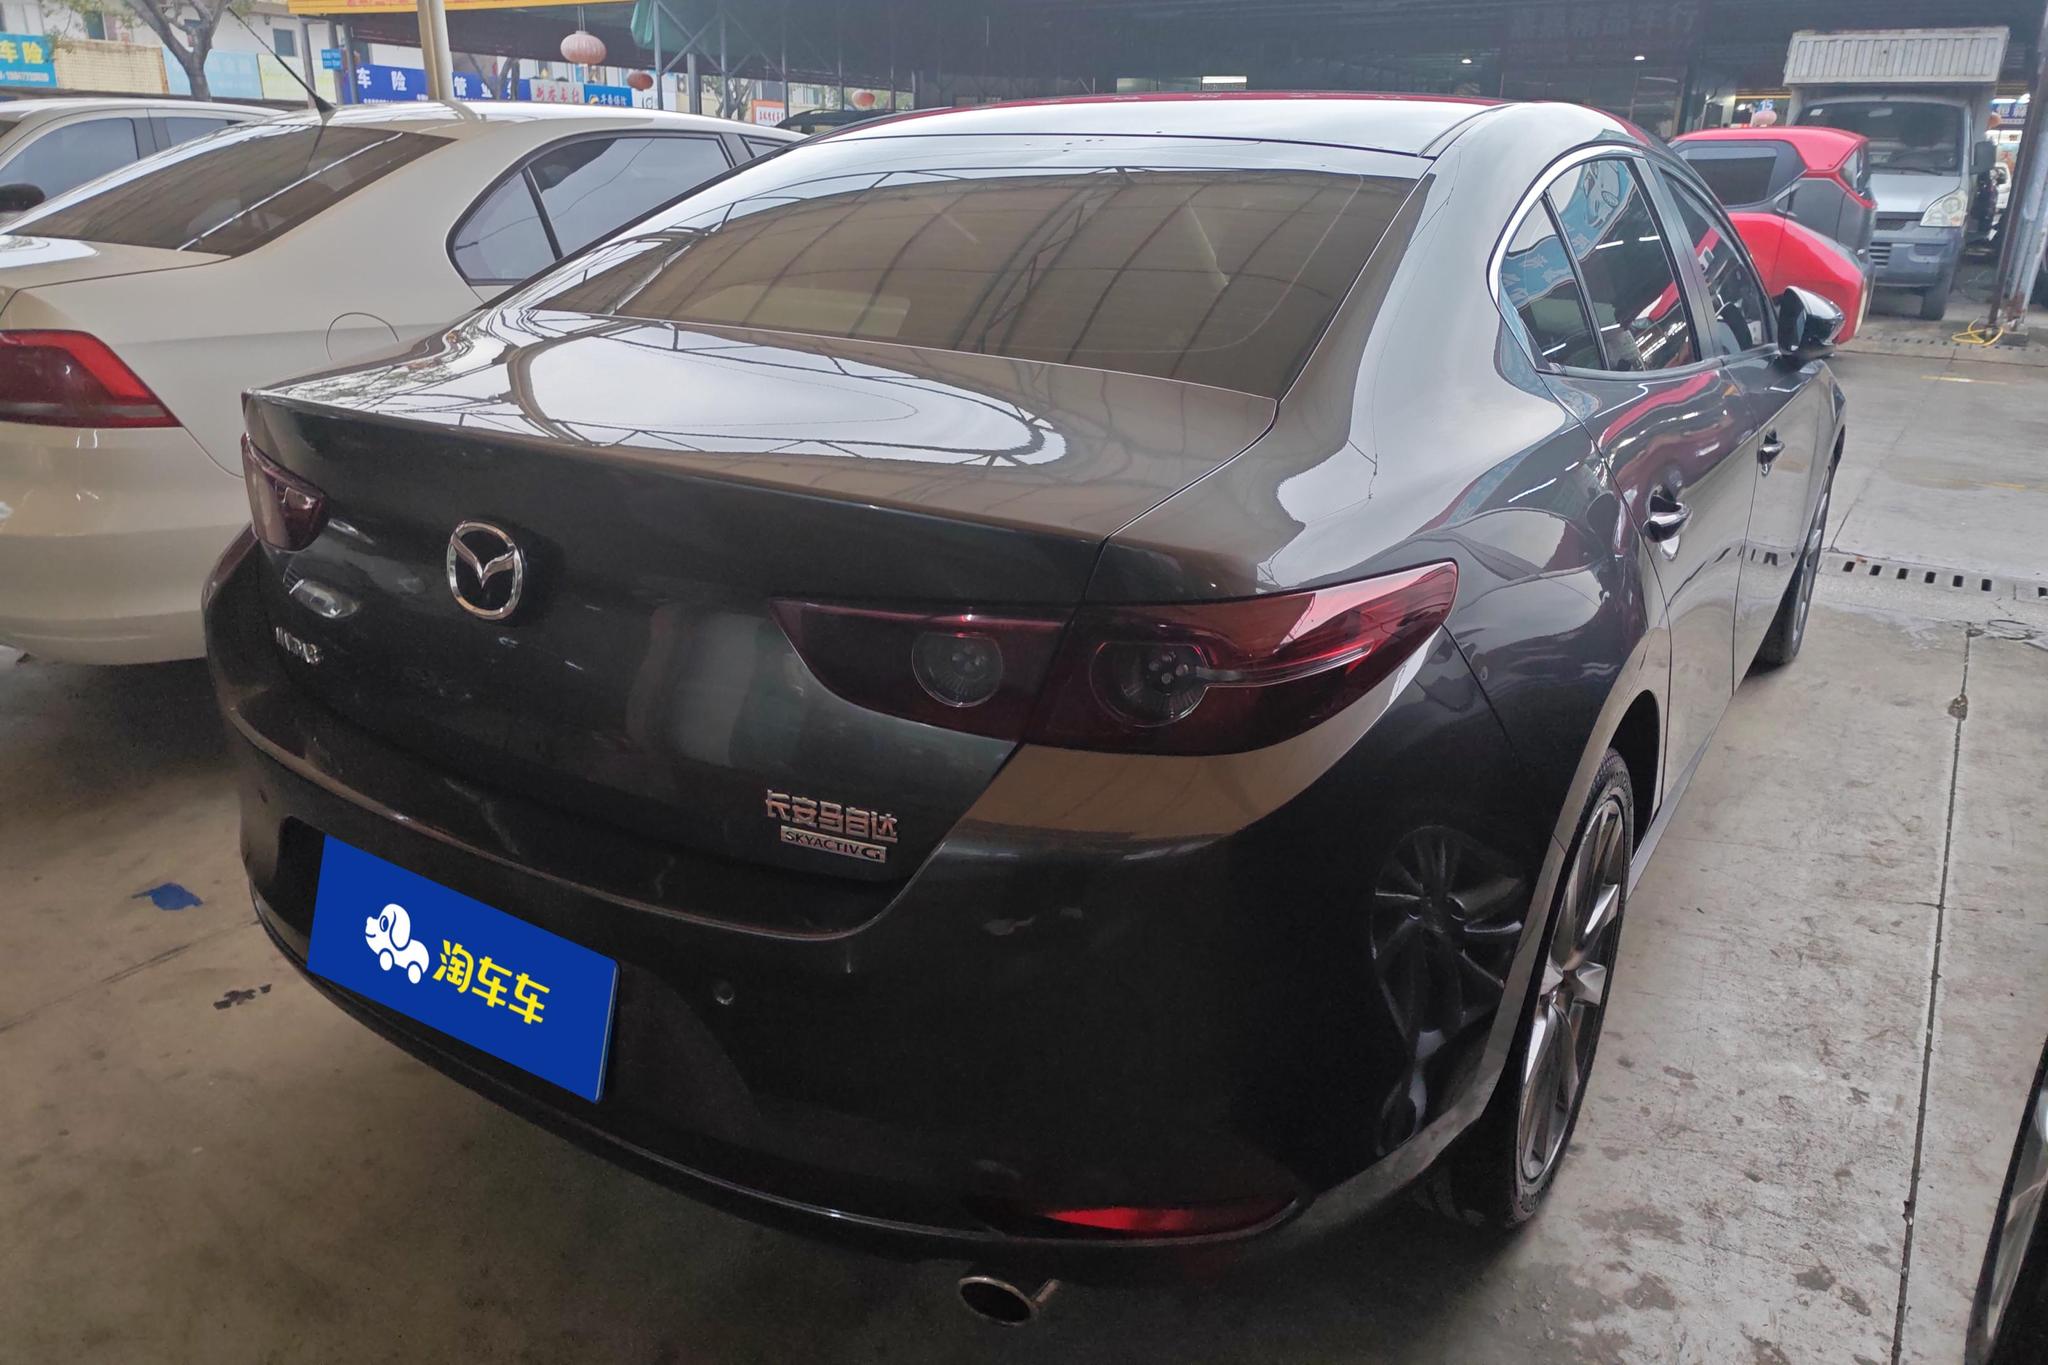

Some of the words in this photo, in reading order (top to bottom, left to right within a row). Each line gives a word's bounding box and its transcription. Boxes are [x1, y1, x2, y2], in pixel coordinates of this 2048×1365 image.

[766, 789, 899, 844] 长安马自达
